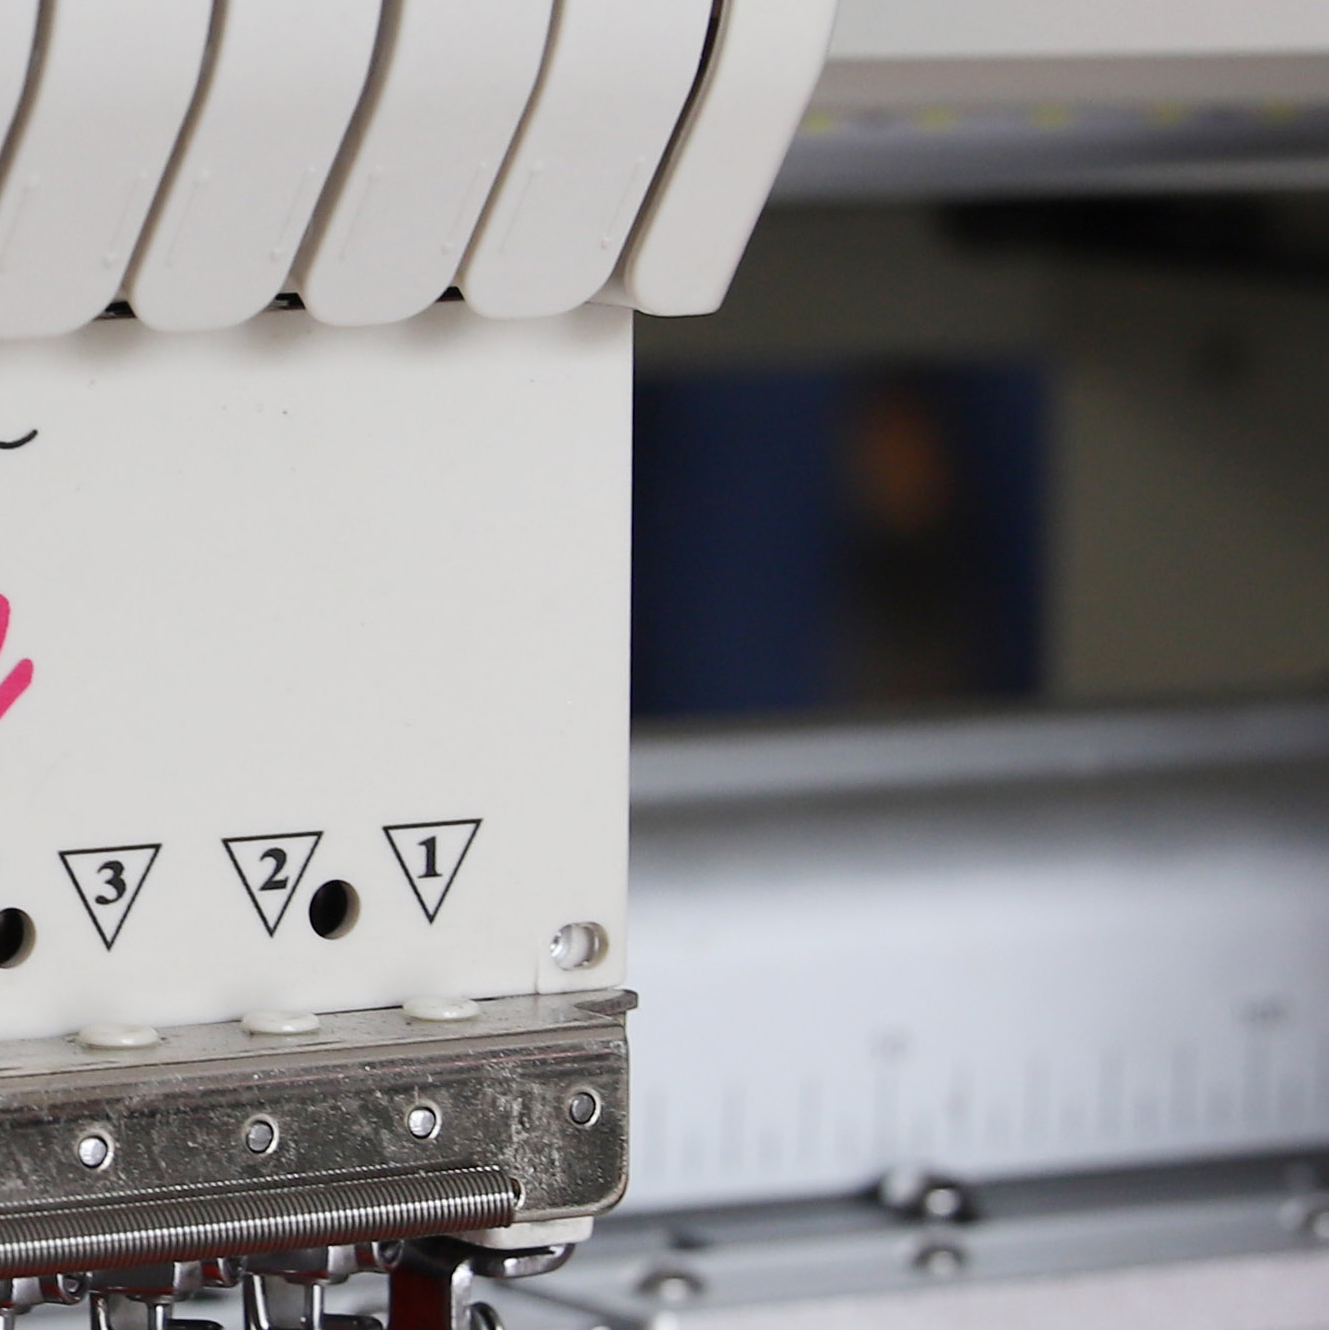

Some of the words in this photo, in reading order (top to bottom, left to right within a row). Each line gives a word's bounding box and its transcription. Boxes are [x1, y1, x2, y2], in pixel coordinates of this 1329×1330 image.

[94, 860, 127, 906] 3
[259, 847, 289, 892] 2
[418, 836, 442, 879] 1
